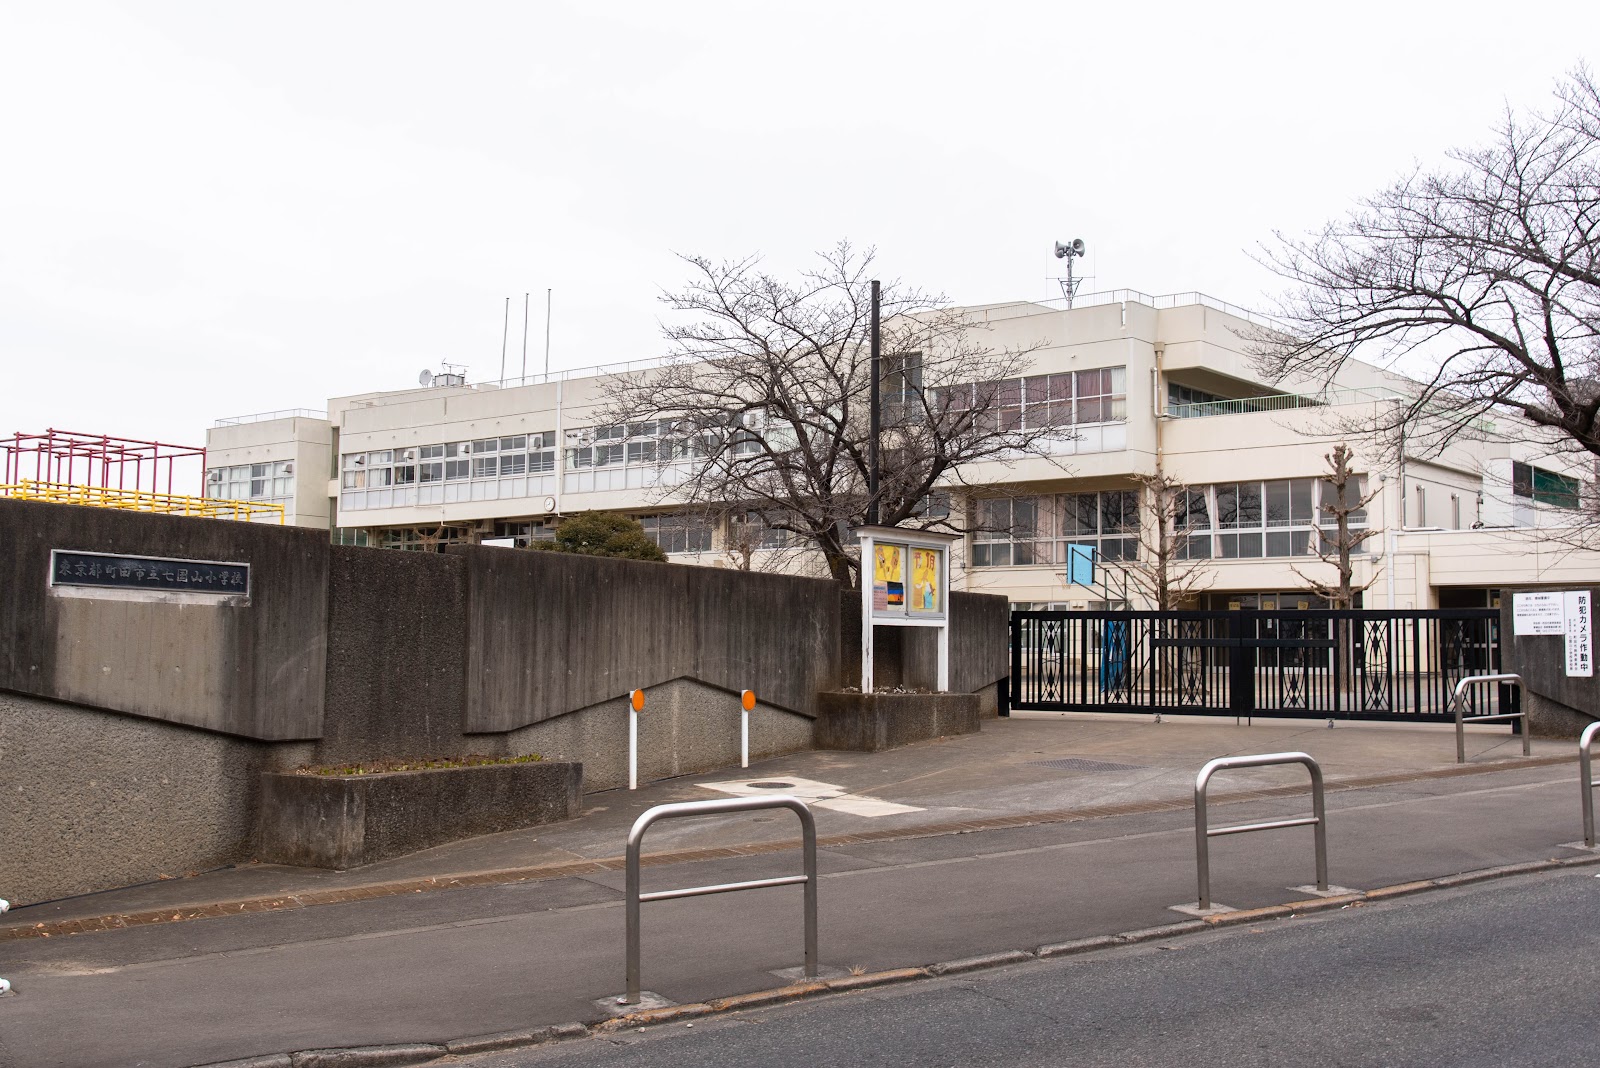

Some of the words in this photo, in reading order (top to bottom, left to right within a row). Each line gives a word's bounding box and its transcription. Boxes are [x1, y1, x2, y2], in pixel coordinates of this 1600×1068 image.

[58, 559, 244, 586] 東京都町田市立七国山小学校
[1578, 596, 1588, 671] 防犯カメラ作動中
